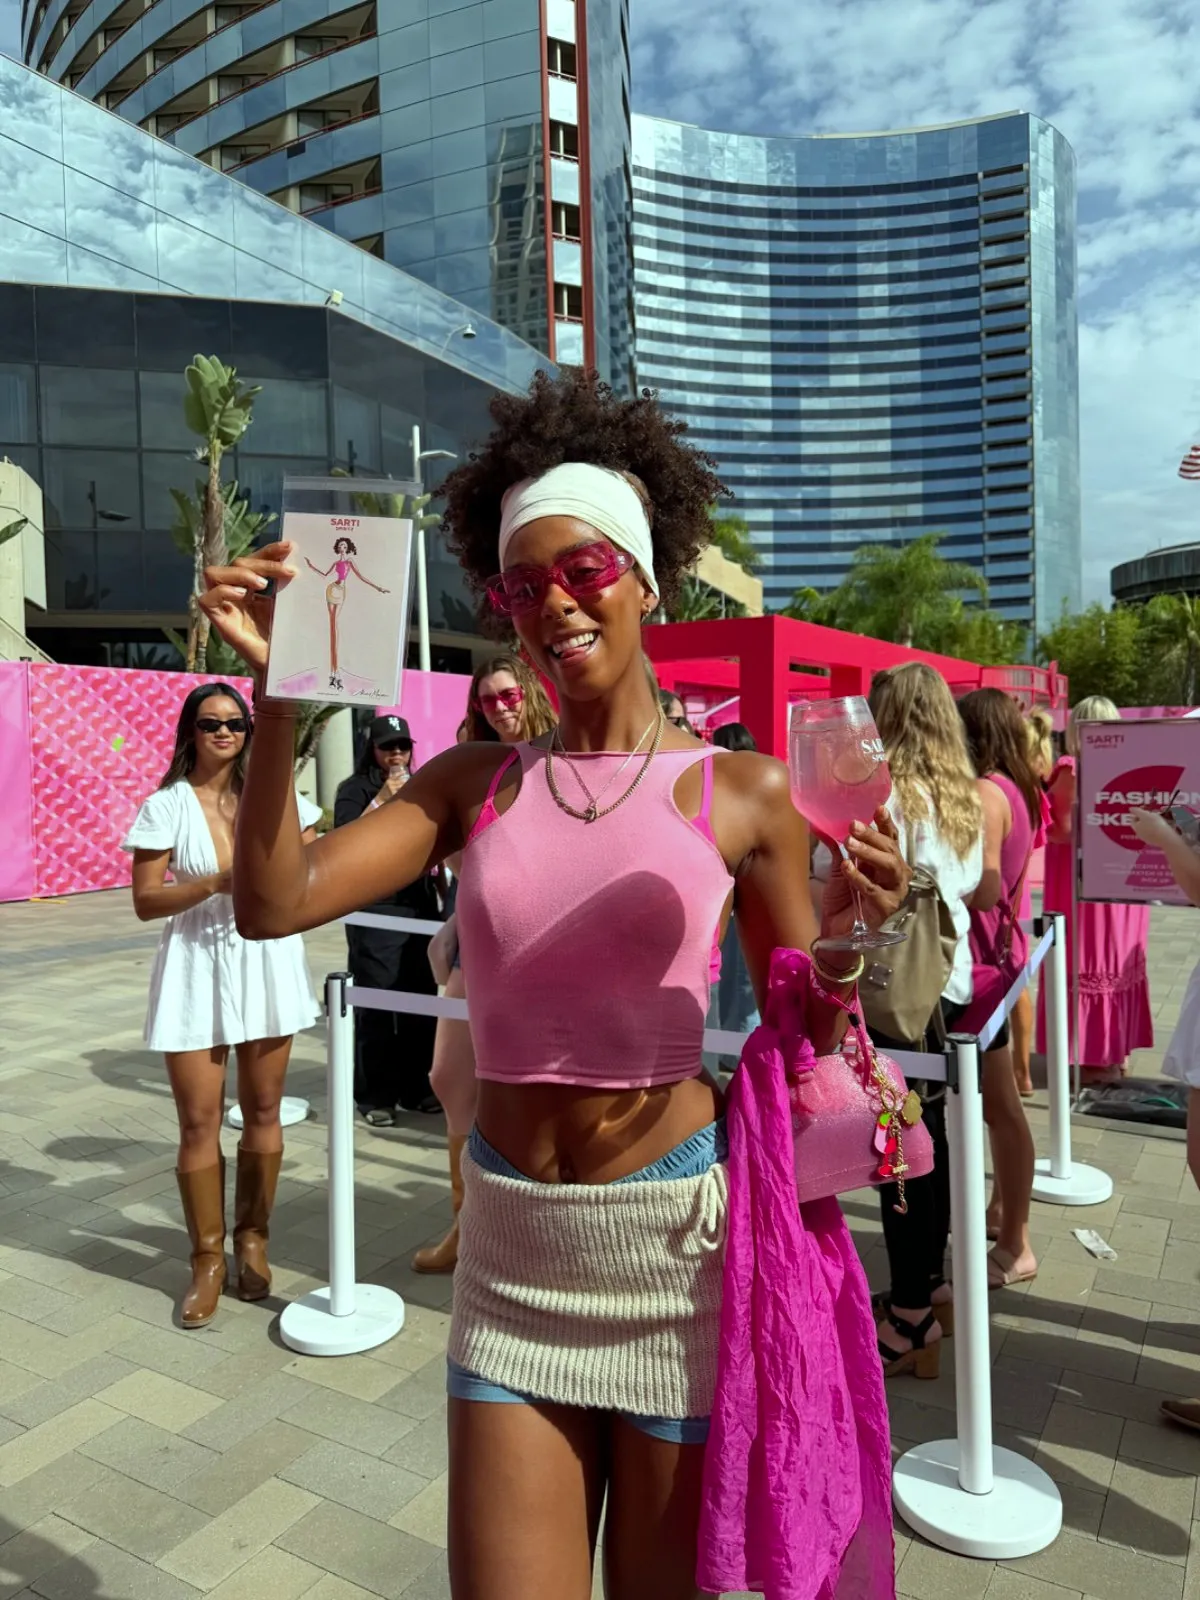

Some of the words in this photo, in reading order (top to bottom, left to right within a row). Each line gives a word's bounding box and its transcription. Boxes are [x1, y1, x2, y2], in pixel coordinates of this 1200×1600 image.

[330, 518, 360, 527] SARTI
[1086, 735, 1125, 744] SARTI
[1086, 812, 1133, 826] SKE
